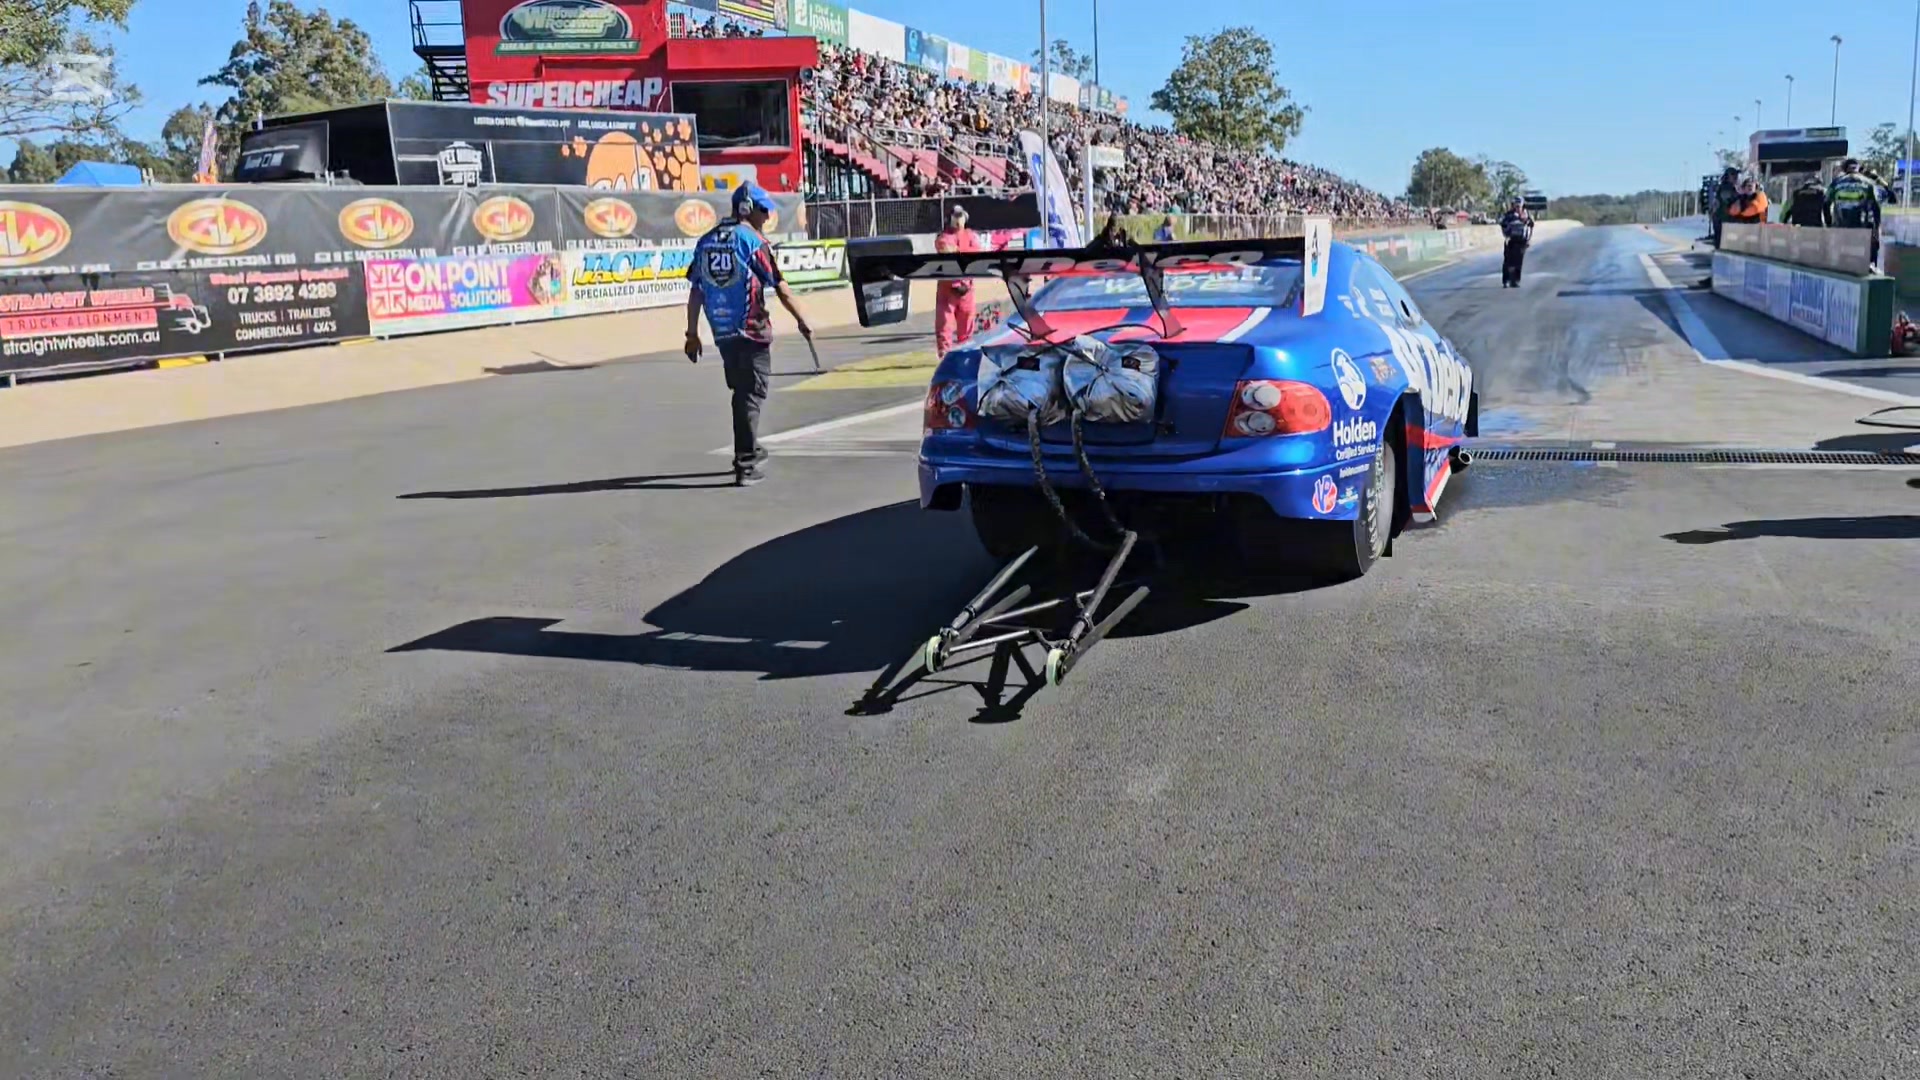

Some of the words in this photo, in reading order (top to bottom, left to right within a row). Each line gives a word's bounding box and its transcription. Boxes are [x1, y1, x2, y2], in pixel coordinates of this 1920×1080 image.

[809, 4, 844, 36] Ipswich
[487, 77, 662, 107] SUPERCHEAP
[572, 252, 656, 286] JACK
[710, 253, 733, 271] 20
[775, 246, 845, 272] DRAG
[405, 260, 509, 293] ON.POINT
[227, 288, 249, 304] 07
[407, 293, 445, 312] MEDIA
[451, 288, 512, 309] SOLUTIONS
[575, 285, 635, 300] SPECIALIZED
[8, 319, 59, 332] TRUCK
[67, 311, 151, 326] ALIGNMENT
[239, 310, 276, 325] TRUCKS
[287, 306, 331, 320] TRAILERS
[2, 330, 161, 356] straightwheels.com.au
[235, 324, 302, 342] COMMERCIALS
[1333, 416, 1377, 447] Holden
